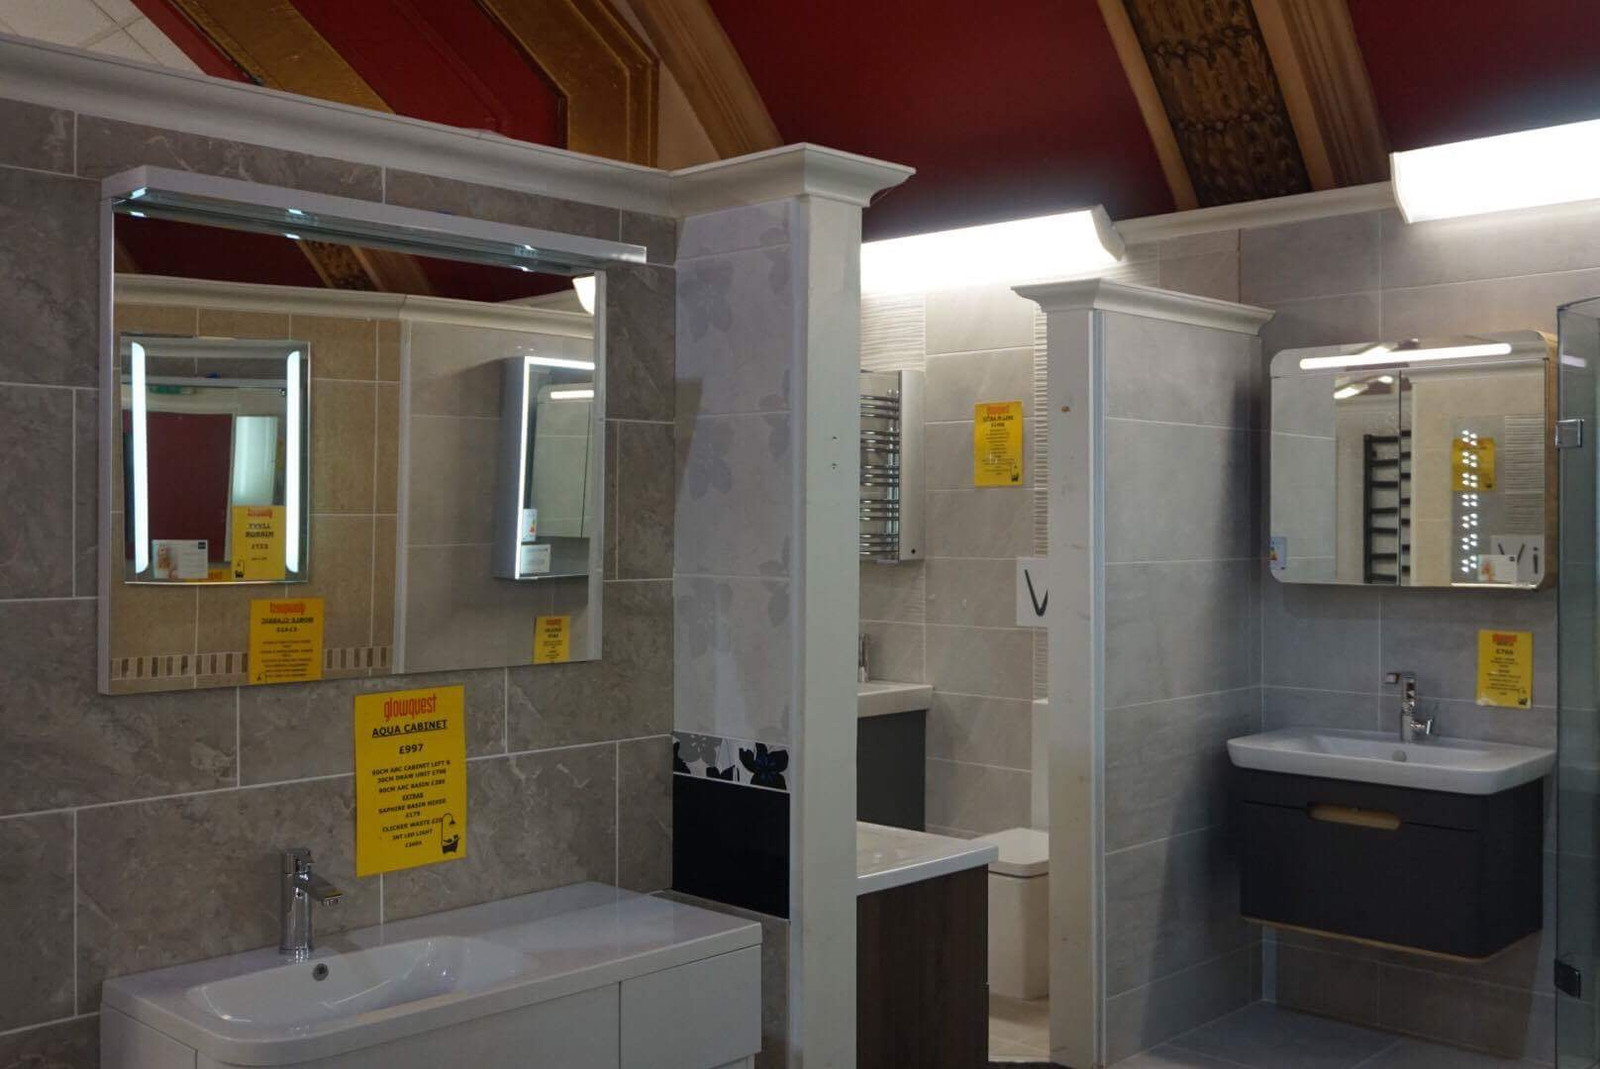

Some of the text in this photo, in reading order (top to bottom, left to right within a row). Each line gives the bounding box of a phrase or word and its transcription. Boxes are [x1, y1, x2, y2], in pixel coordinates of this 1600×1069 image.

[383, 693, 437, 722] glowquest
[372, 719, 448, 737] AQUA CABINET
[399, 743, 424, 754] £997
[404, 761, 430, 772] CABINET
[431, 759, 444, 768] LEFT
[395, 773, 413, 781] DRAW
[415, 770, 430, 779] UNIT
[410, 781, 429, 789] BASIN
[402, 793, 424, 801] EXTRAS
[407, 801, 426, 810] BASIN
[382, 823, 409, 832] CLICKER
[410, 819, 430, 828] WASTE
